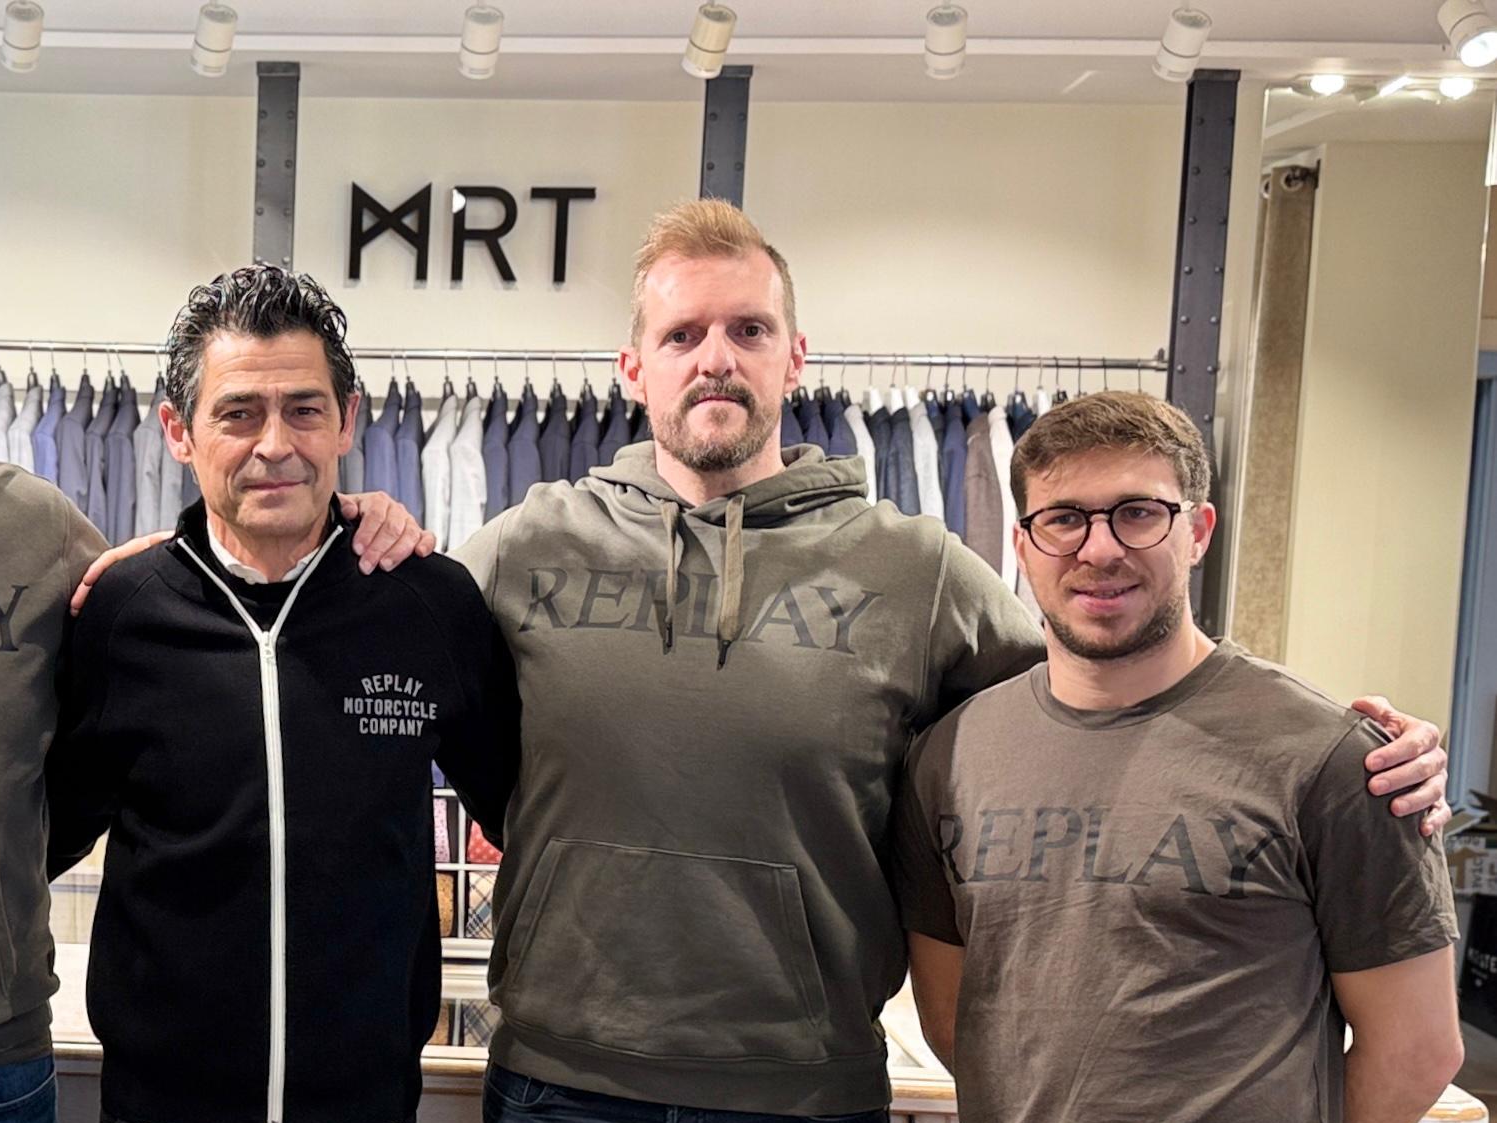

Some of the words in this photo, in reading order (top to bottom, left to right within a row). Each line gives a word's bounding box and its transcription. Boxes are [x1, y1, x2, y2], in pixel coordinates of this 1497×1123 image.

[348, 181, 597, 283] MRT
[360, 673, 424, 698] REPLAY
[343, 697, 438, 720] MOTORCYCLE
[359, 717, 424, 737] COMPANY
